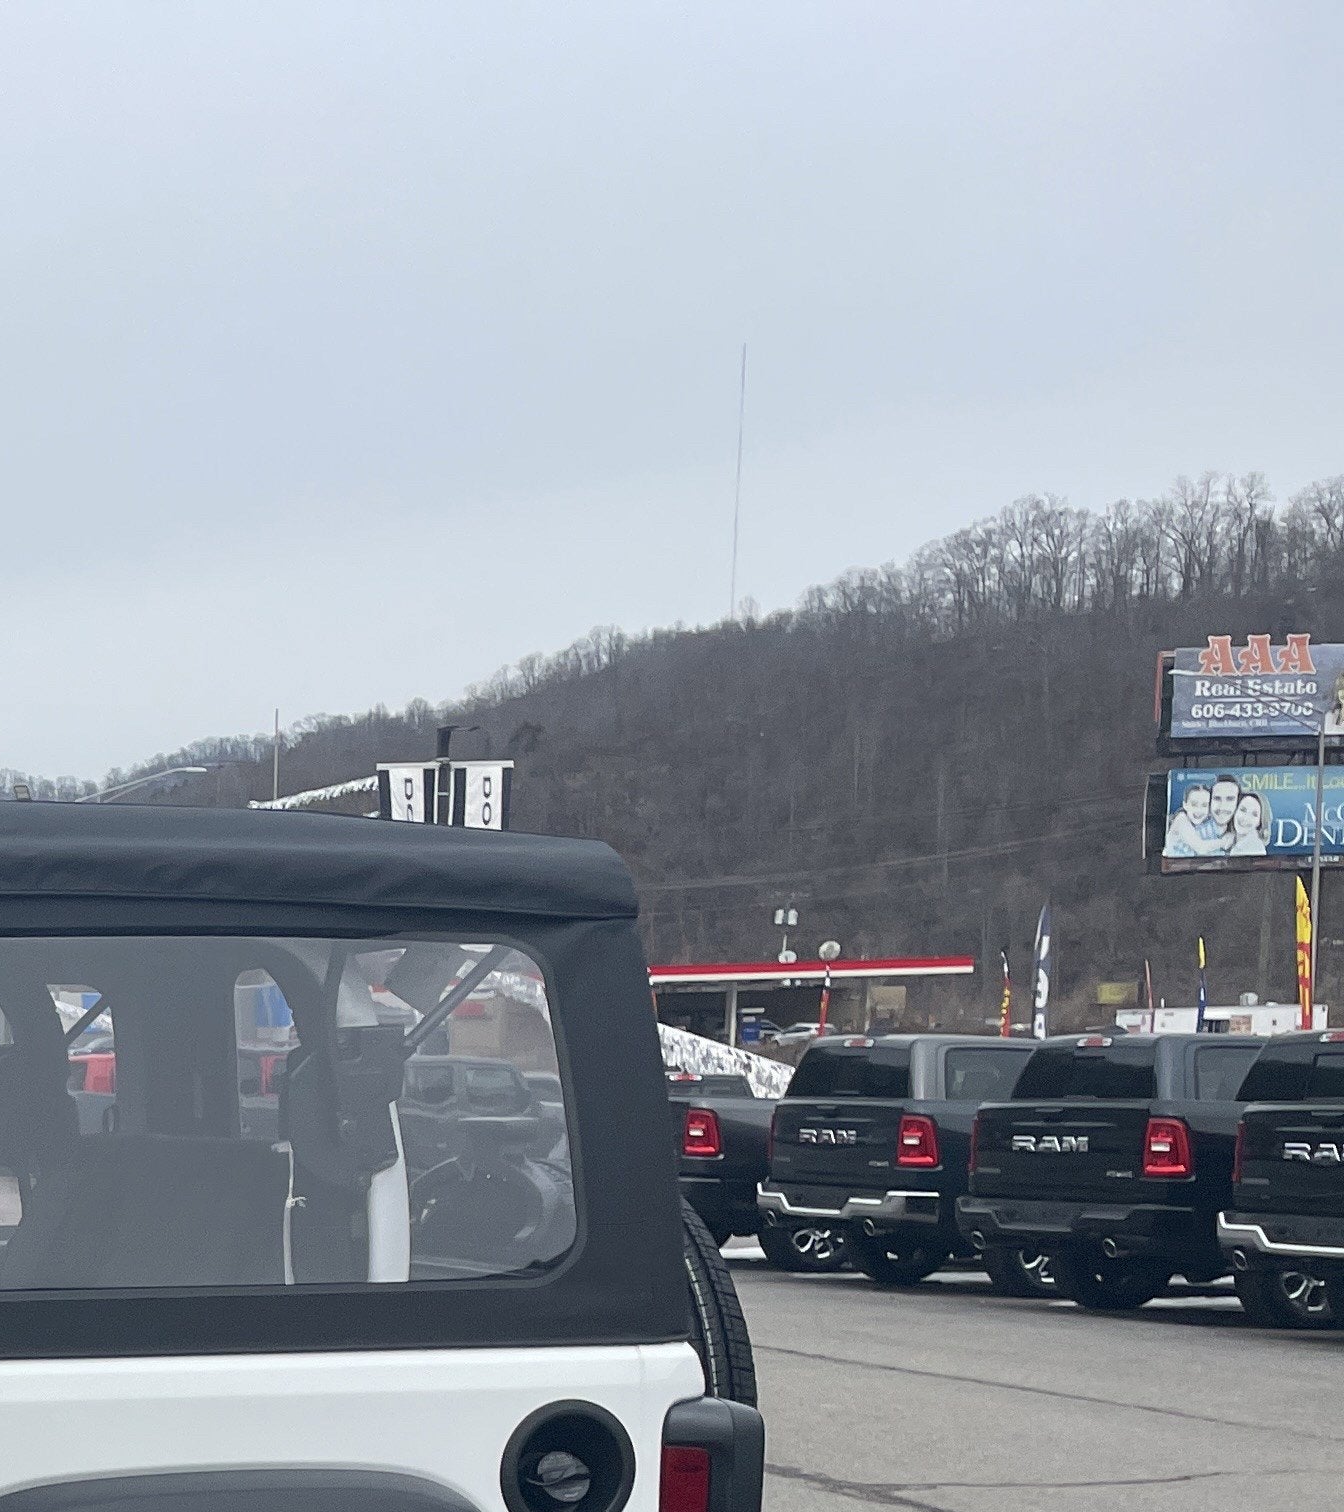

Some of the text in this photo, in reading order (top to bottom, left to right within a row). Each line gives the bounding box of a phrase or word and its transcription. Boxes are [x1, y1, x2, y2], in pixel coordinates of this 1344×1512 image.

[1198, 632, 1317, 676] AAA
[798, 1128, 857, 1145] RAM
[1012, 1135, 1089, 1152] RAM
[1283, 1142, 1344, 1162] RA
